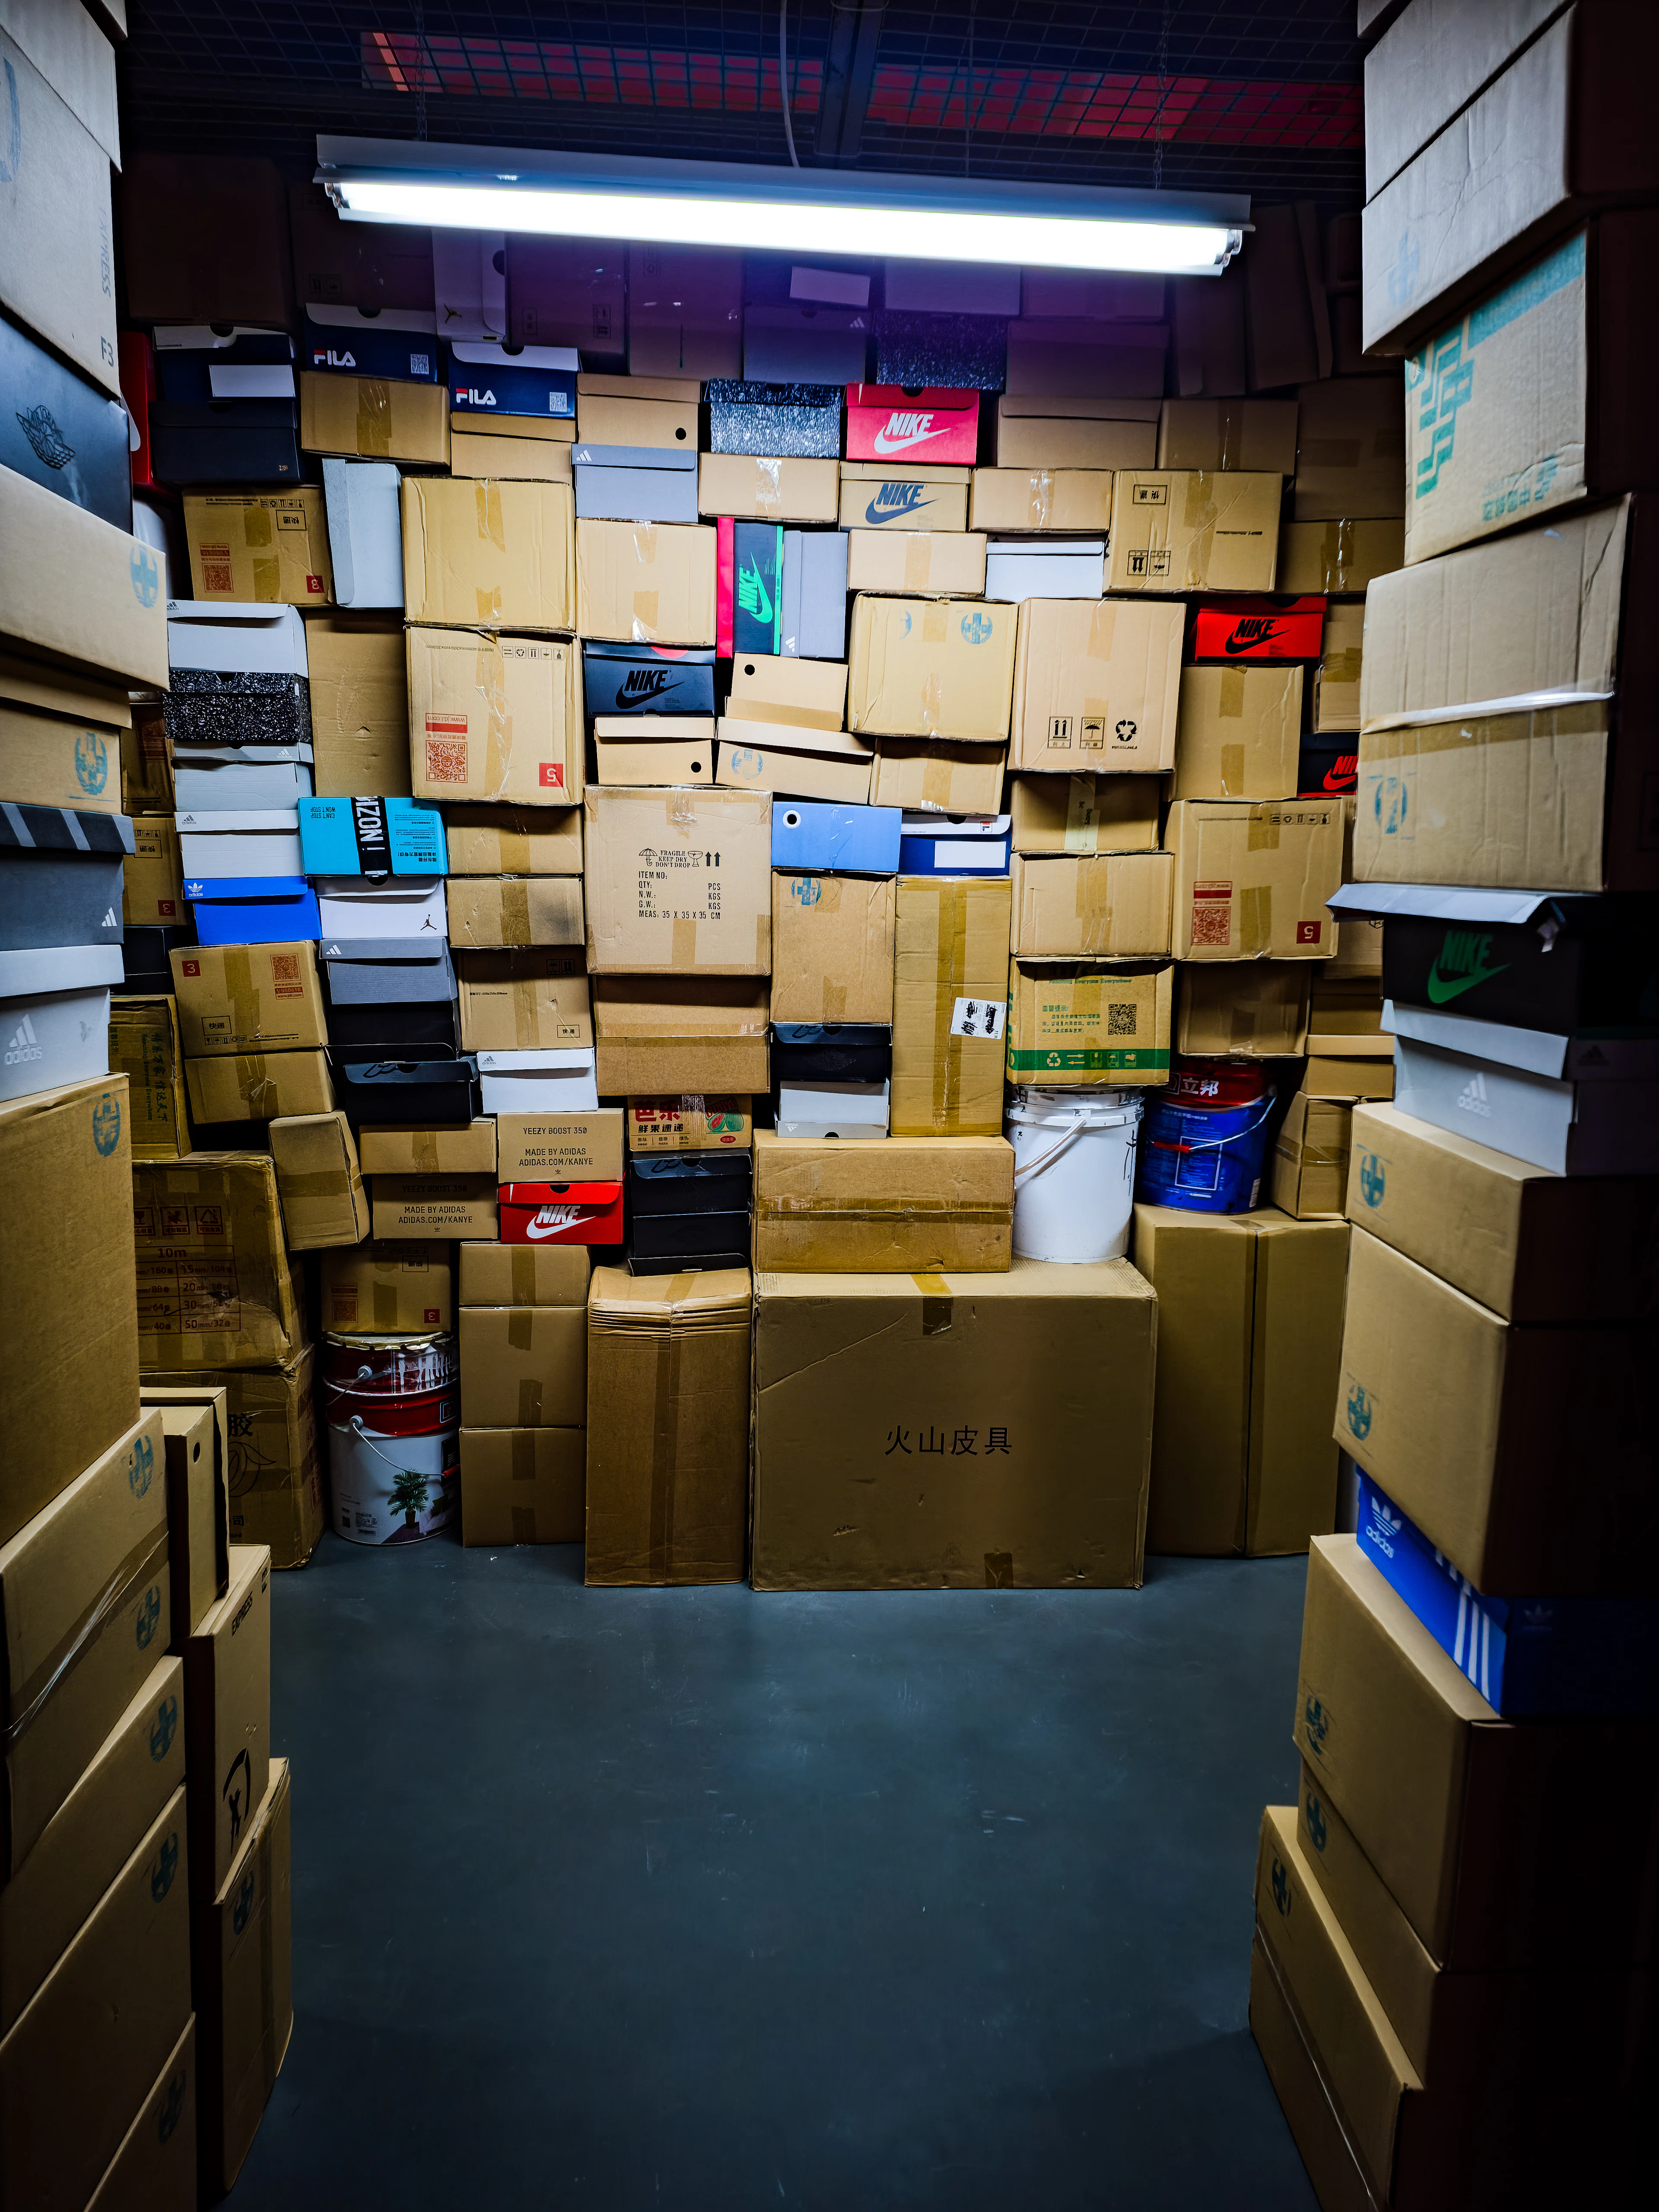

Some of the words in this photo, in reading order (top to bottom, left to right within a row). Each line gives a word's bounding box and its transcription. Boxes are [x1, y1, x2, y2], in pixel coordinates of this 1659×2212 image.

[101, 335, 114, 367] F3
[314, 349, 356, 367] FILA
[456, 388, 496, 406] FILA
[886, 413, 934, 436] NIKE
[875, 483, 924, 506] NIKE
[311, 579, 319, 589] 3
[738, 566, 758, 614] NIKE
[1234, 618, 1275, 638] NIKE
[625, 670, 668, 692] NIKE
[547, 768, 556, 782] 5
[163, 903, 171, 913] 3
[1304, 926, 1313, 939] 5
[1441, 930, 1494, 972] NIKE
[188, 963, 195, 973] 3
[634, 1100, 680, 1122] 芭乐
[519, 1158, 593, 1166] ADIDAS.COM/KANYE
[536, 1205, 581, 1224] NIKE
[158, 1248, 187, 1258] 10m
[428, 1312, 436, 1321] 3
[884, 1424, 1012, 1456] 火山皮具
